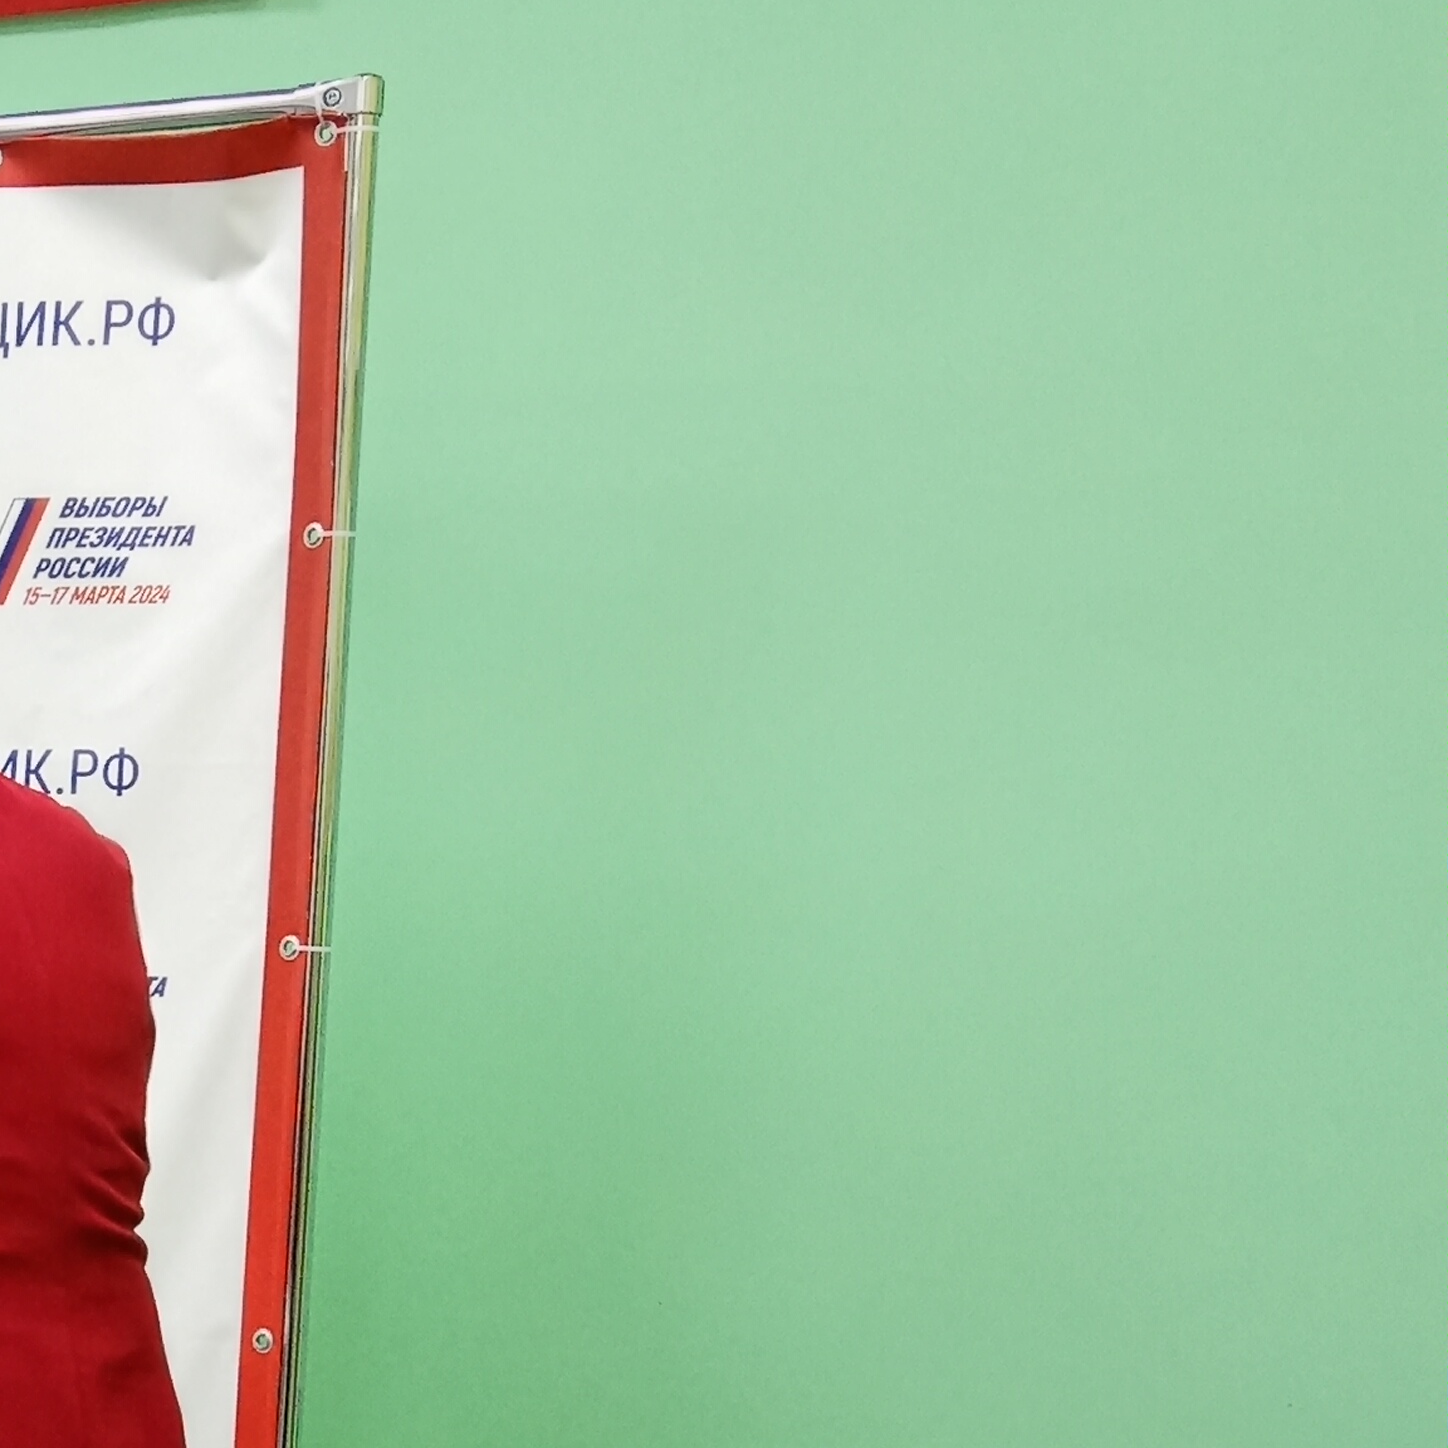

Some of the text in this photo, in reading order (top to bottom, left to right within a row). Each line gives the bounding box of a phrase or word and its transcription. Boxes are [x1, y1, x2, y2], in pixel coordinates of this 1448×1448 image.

[59, 496, 168, 518] ВЫБОРЫ
[46, 525, 196, 551] ПРЕЗИДЕНТА
[33, 556, 129, 579] РОССИИ
[71, 585, 126, 605] МАРТА
[127, 584, 171, 604] 2024
